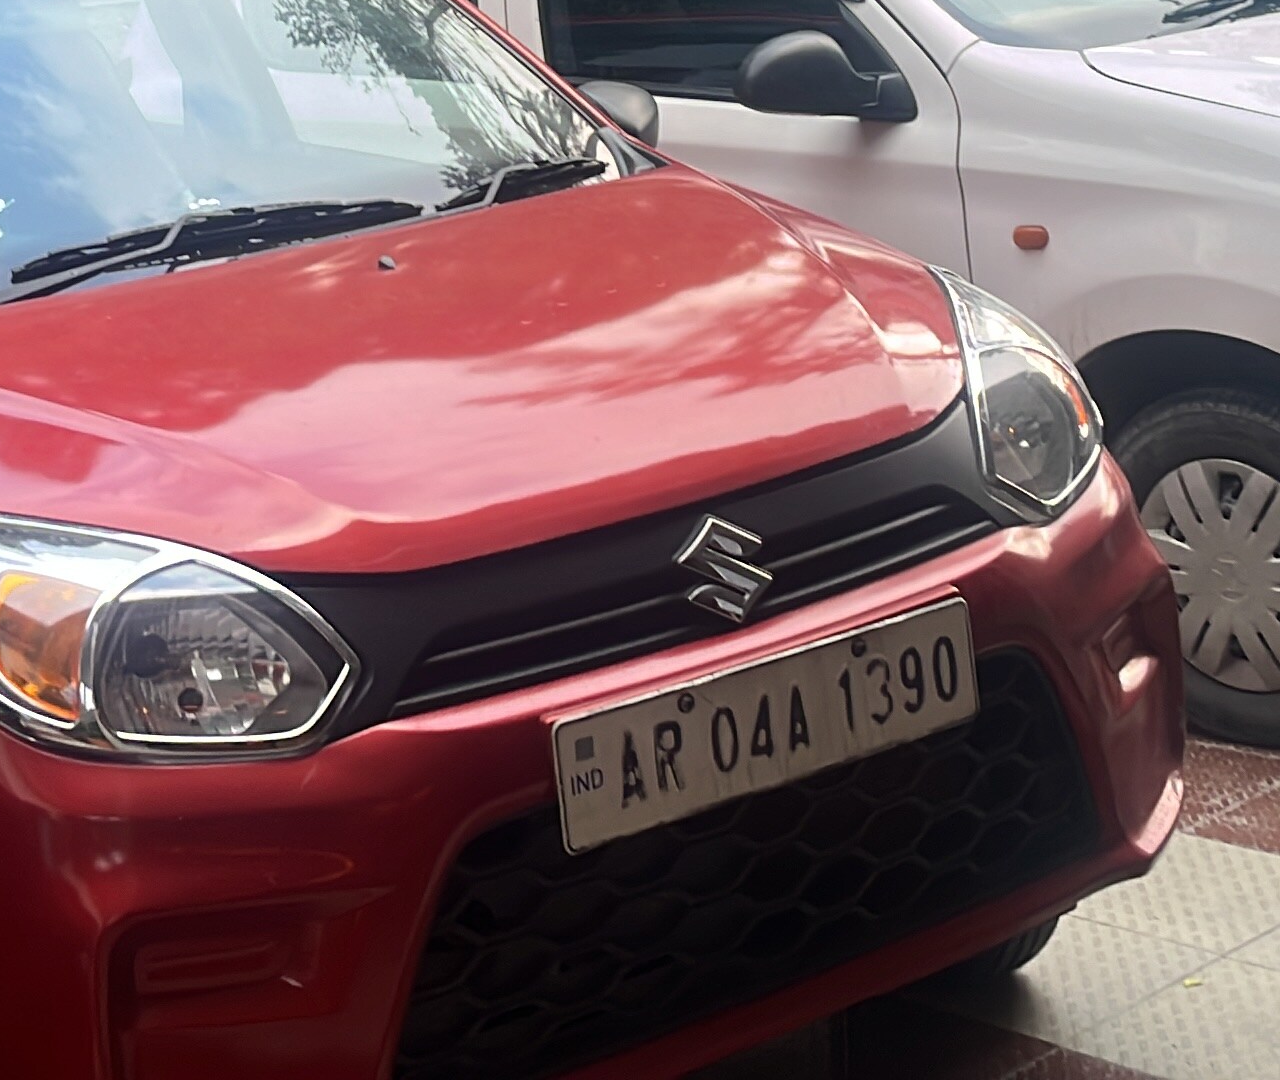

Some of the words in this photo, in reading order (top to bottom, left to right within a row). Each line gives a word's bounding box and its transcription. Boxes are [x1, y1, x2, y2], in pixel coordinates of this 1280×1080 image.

[570, 766, 605, 797] IND
[621, 720, 684, 808] AR
[711, 684, 810, 773] 04A
[837, 635, 959, 734] 1390
